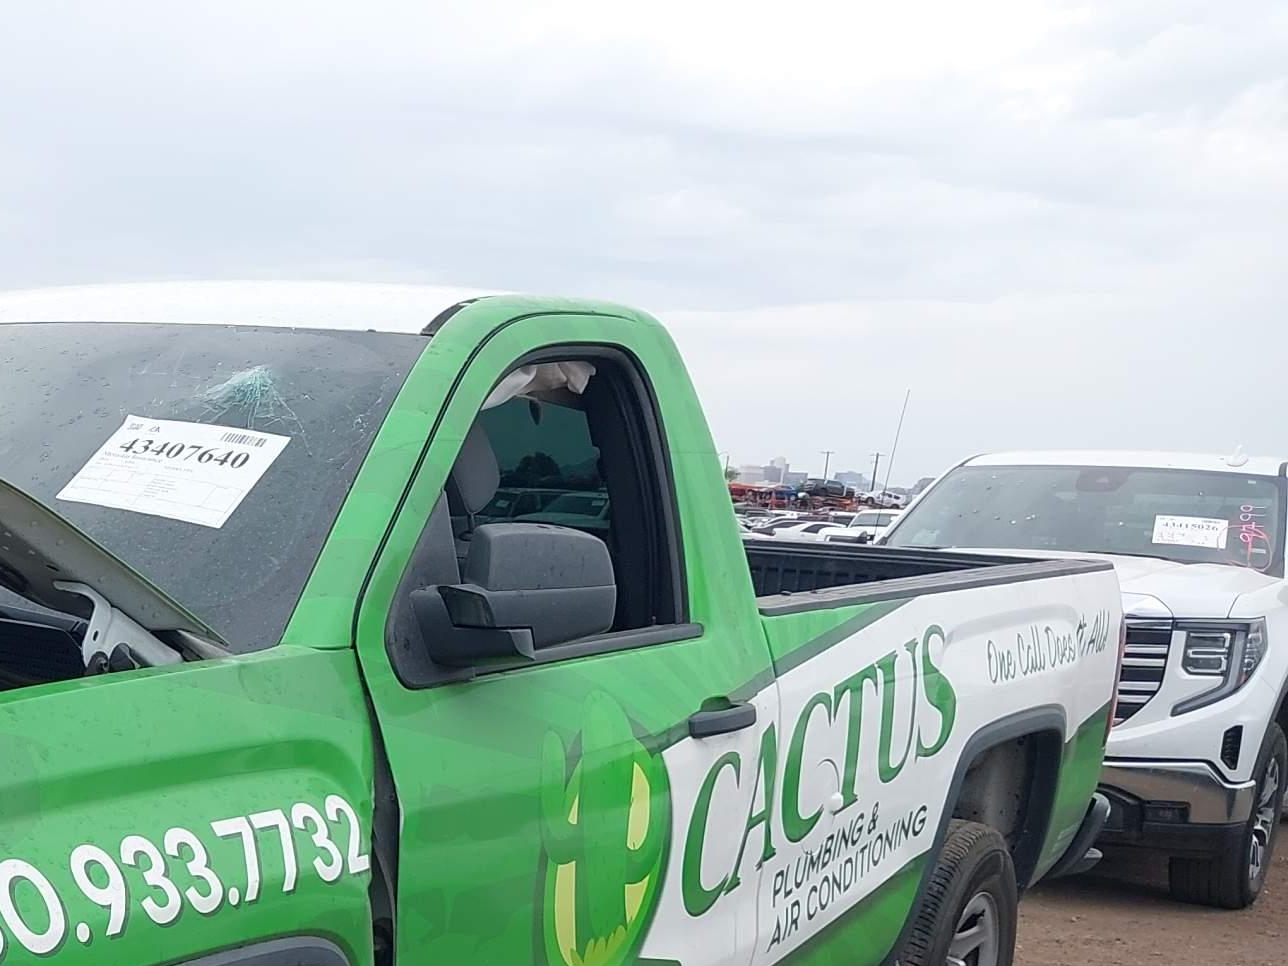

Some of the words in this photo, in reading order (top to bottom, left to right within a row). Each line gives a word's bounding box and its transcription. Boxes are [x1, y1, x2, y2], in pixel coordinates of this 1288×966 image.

[120, 438, 250, 469] 43407640
[987, 640, 1016, 684] One
[1016, 624, 1045, 676] Call
[1044, 626, 1076, 668] Does
[681, 624, 956, 917] CACTUS
[766, 900, 800, 953] AIR
[807, 805, 927, 920] CONDITIONING
[772, 812, 864, 908] PLUMBING
[867, 801, 879, 835] &
